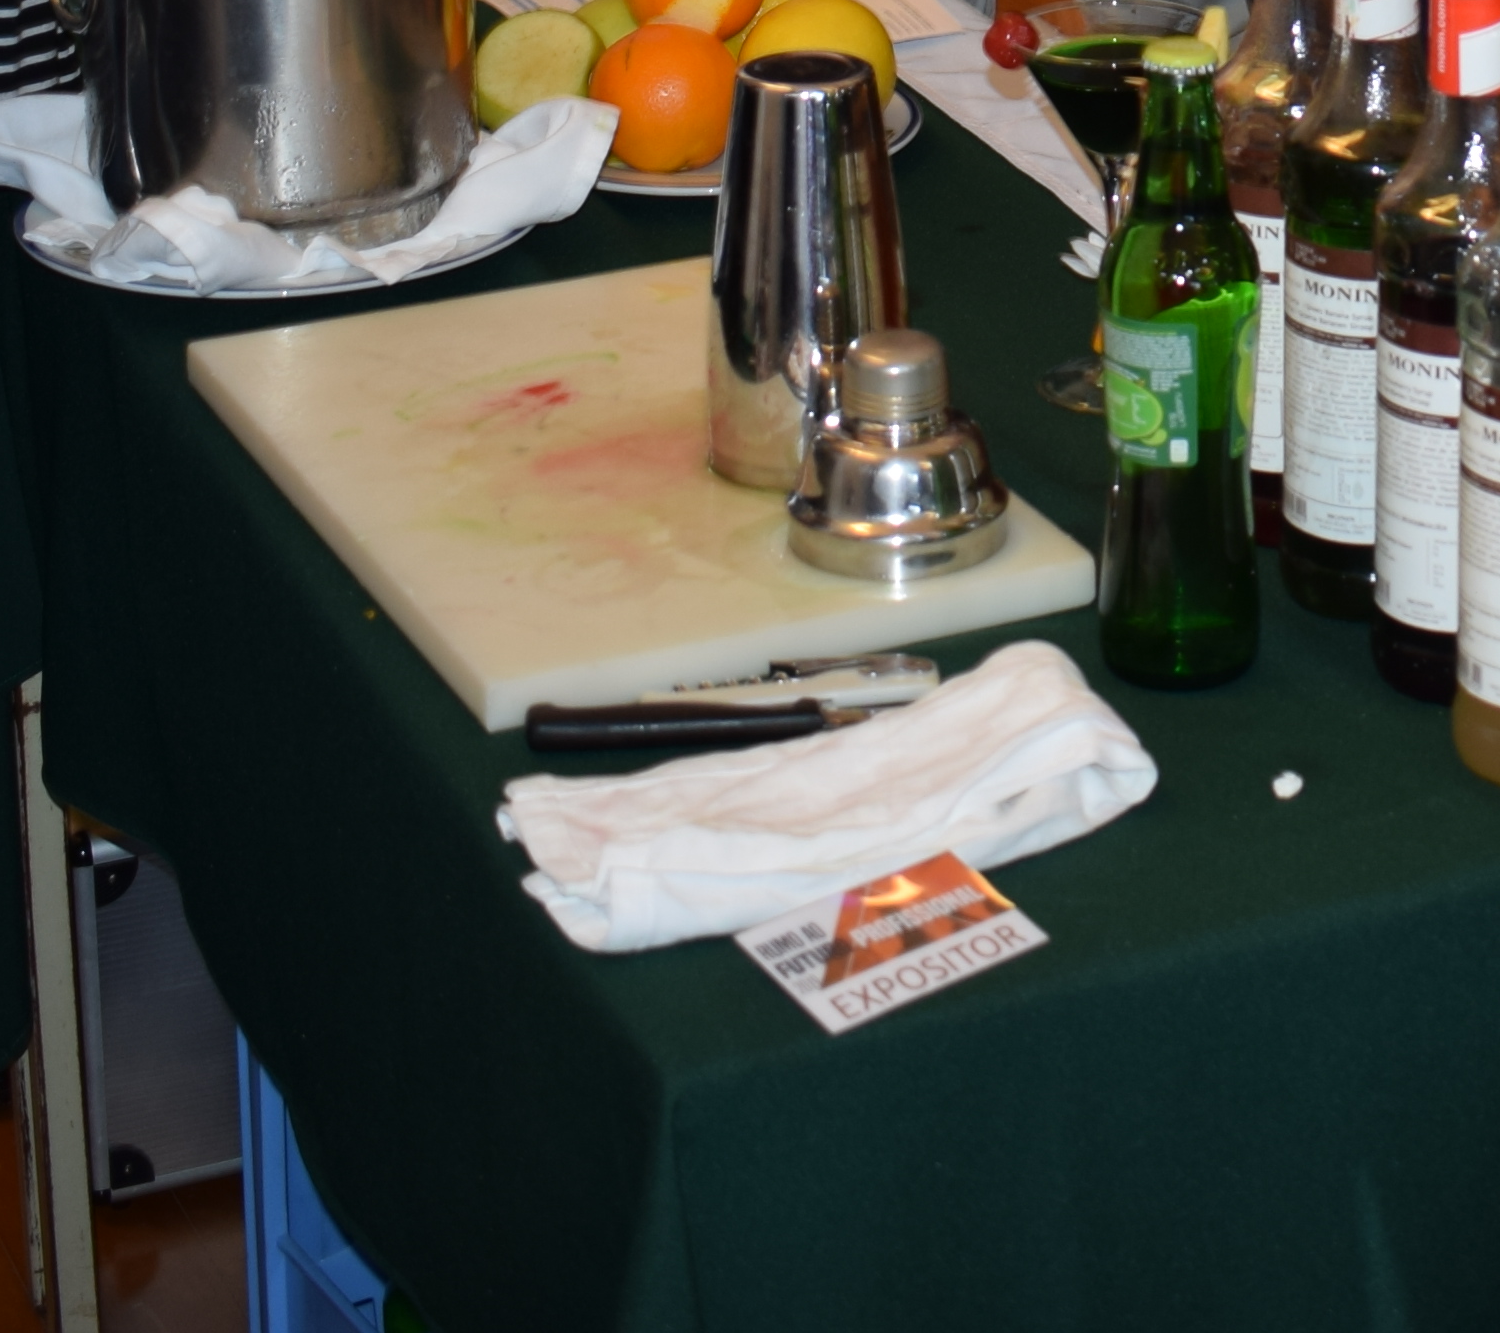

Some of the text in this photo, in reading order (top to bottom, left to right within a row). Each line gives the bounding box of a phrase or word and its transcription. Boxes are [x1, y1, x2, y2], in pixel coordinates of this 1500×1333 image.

[1304, 278, 1378, 303] MONIN
[1388, 351, 1460, 381] MONIN
[848, 885, 986, 949] PROFISSIONAL
[754, 921, 827, 961] RUMO AO
[829, 924, 1029, 1020] EXPOSITOR
